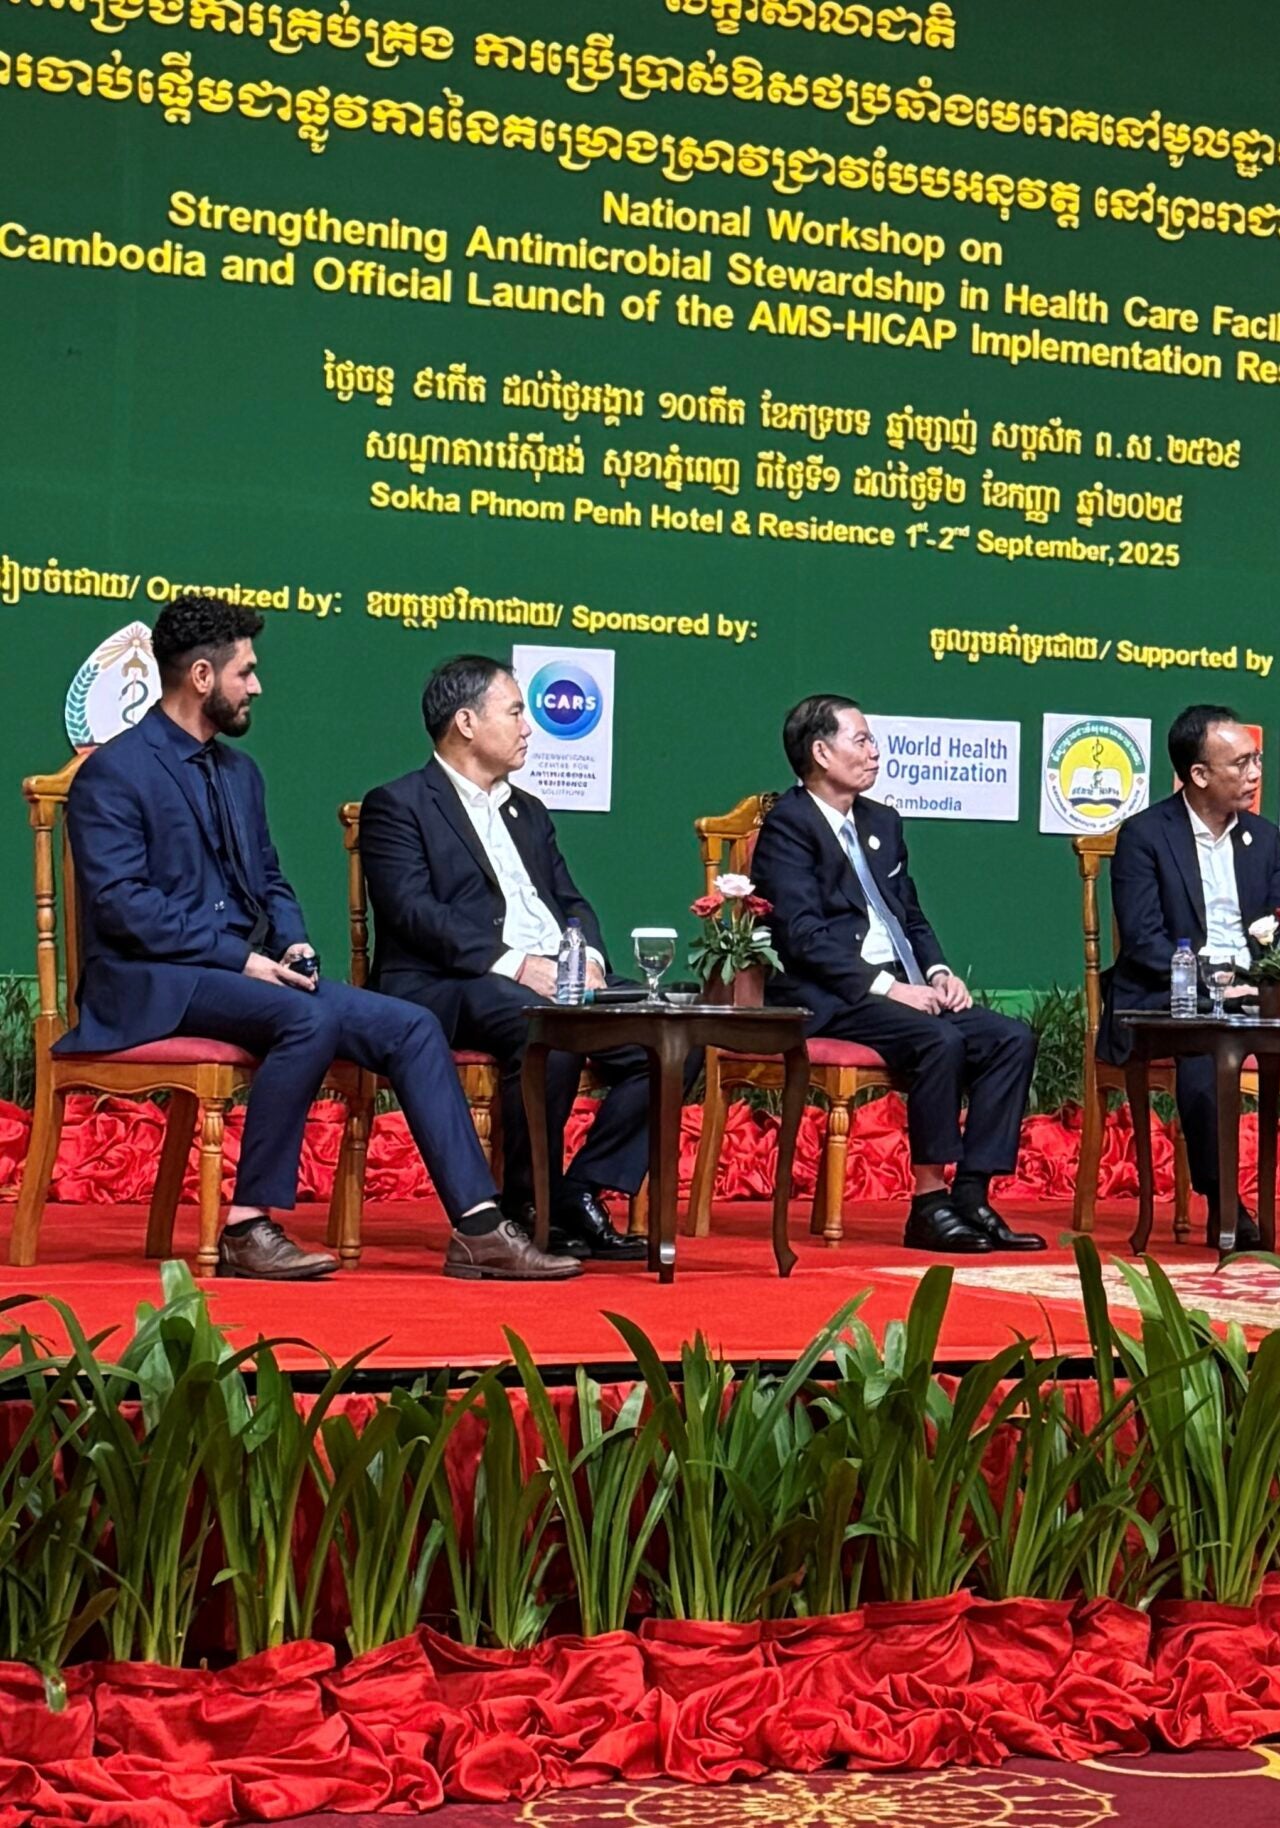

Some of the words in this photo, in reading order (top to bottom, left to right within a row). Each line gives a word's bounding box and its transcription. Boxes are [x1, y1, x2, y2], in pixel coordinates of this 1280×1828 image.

[603, 191, 751, 238] National
[766, 208, 946, 266] Workshop
[960, 239, 1003, 266] on
[168, 191, 448, 262] Strengthening
[466, 225, 712, 282] Antimicrobial
[728, 253, 946, 312] Stewardship
[960, 279, 989, 312] in
[1004, 283, 1108, 324] Health
[1123, 296, 1199, 333] Care
[0, 222, 206, 277] Cambodia
[222, 252, 295, 286] and
[314, 257, 452, 303] Official
[468, 272, 605, 317] Launch
[621, 290, 662, 322] of
[676, 294, 734, 329] the
[749, 301, 957, 350] AMS-HICAP
[972, 323, 1222, 378] Implementation
[323, 350, 395, 407] ថ្ងៃចន្ទ
[413, 363, 487, 403] ៩កើត
[503, 369, 645, 427] ដល់ថ្ងៃអង្គារ
[658, 386, 746, 425] ១០កើត
[603, 444, 740, 495] សុខាភ្នំពេញ
[756, 451, 841, 500] ពីថ្ងៃទី១
[854, 461, 967, 511] ដល់ថ្ងៃទី២
[982, 470, 1061, 524] ខែកញ្ញា
[1076, 482, 1183, 527] ឆ្នាំ២០២៥
[371, 482, 461, 513] Sokha
[471, 489, 566, 521] Phnom
[574, 498, 642, 527] Penh
[651, 504, 724, 533] Hotel
[730, 511, 752, 536] &
[759, 512, 896, 546] Residence
[298, 587, 341, 617] by:
[572, 605, 710, 636] Sponsored
[718, 614, 758, 643] by:
[1117, 640, 1238, 669] Supported
[1246, 649, 1274, 677] by
[536, 693, 596, 711] ICARS
[887, 735, 942, 757] World
[949, 737, 1008, 760] Health
[886, 758, 1007, 785] Organization
[884, 794, 962, 811] Cambodia
